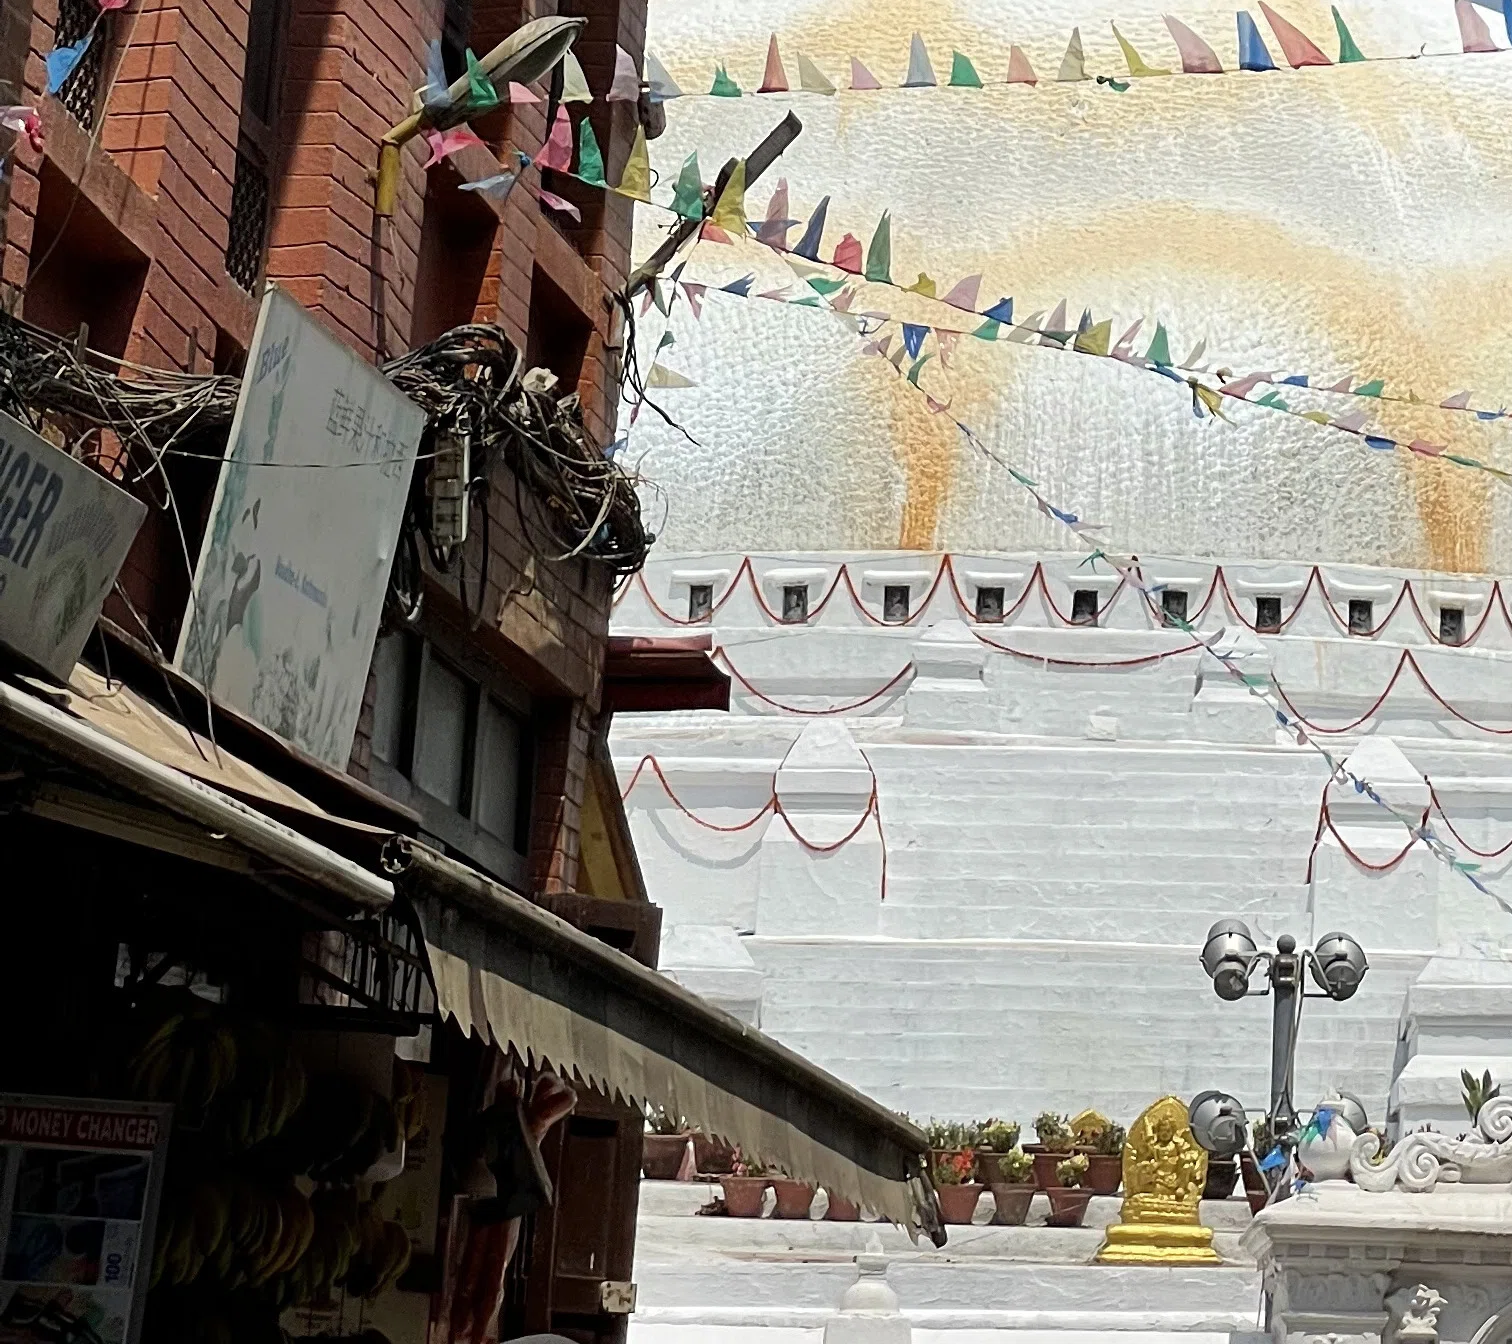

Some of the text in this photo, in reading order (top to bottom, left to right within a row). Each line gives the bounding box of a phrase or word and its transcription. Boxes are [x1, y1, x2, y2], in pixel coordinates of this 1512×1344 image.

[10, 1108, 74, 1139] MONEY
[76, 1114, 160, 1145] CHANGER
[105, 1253, 122, 1283] 100
